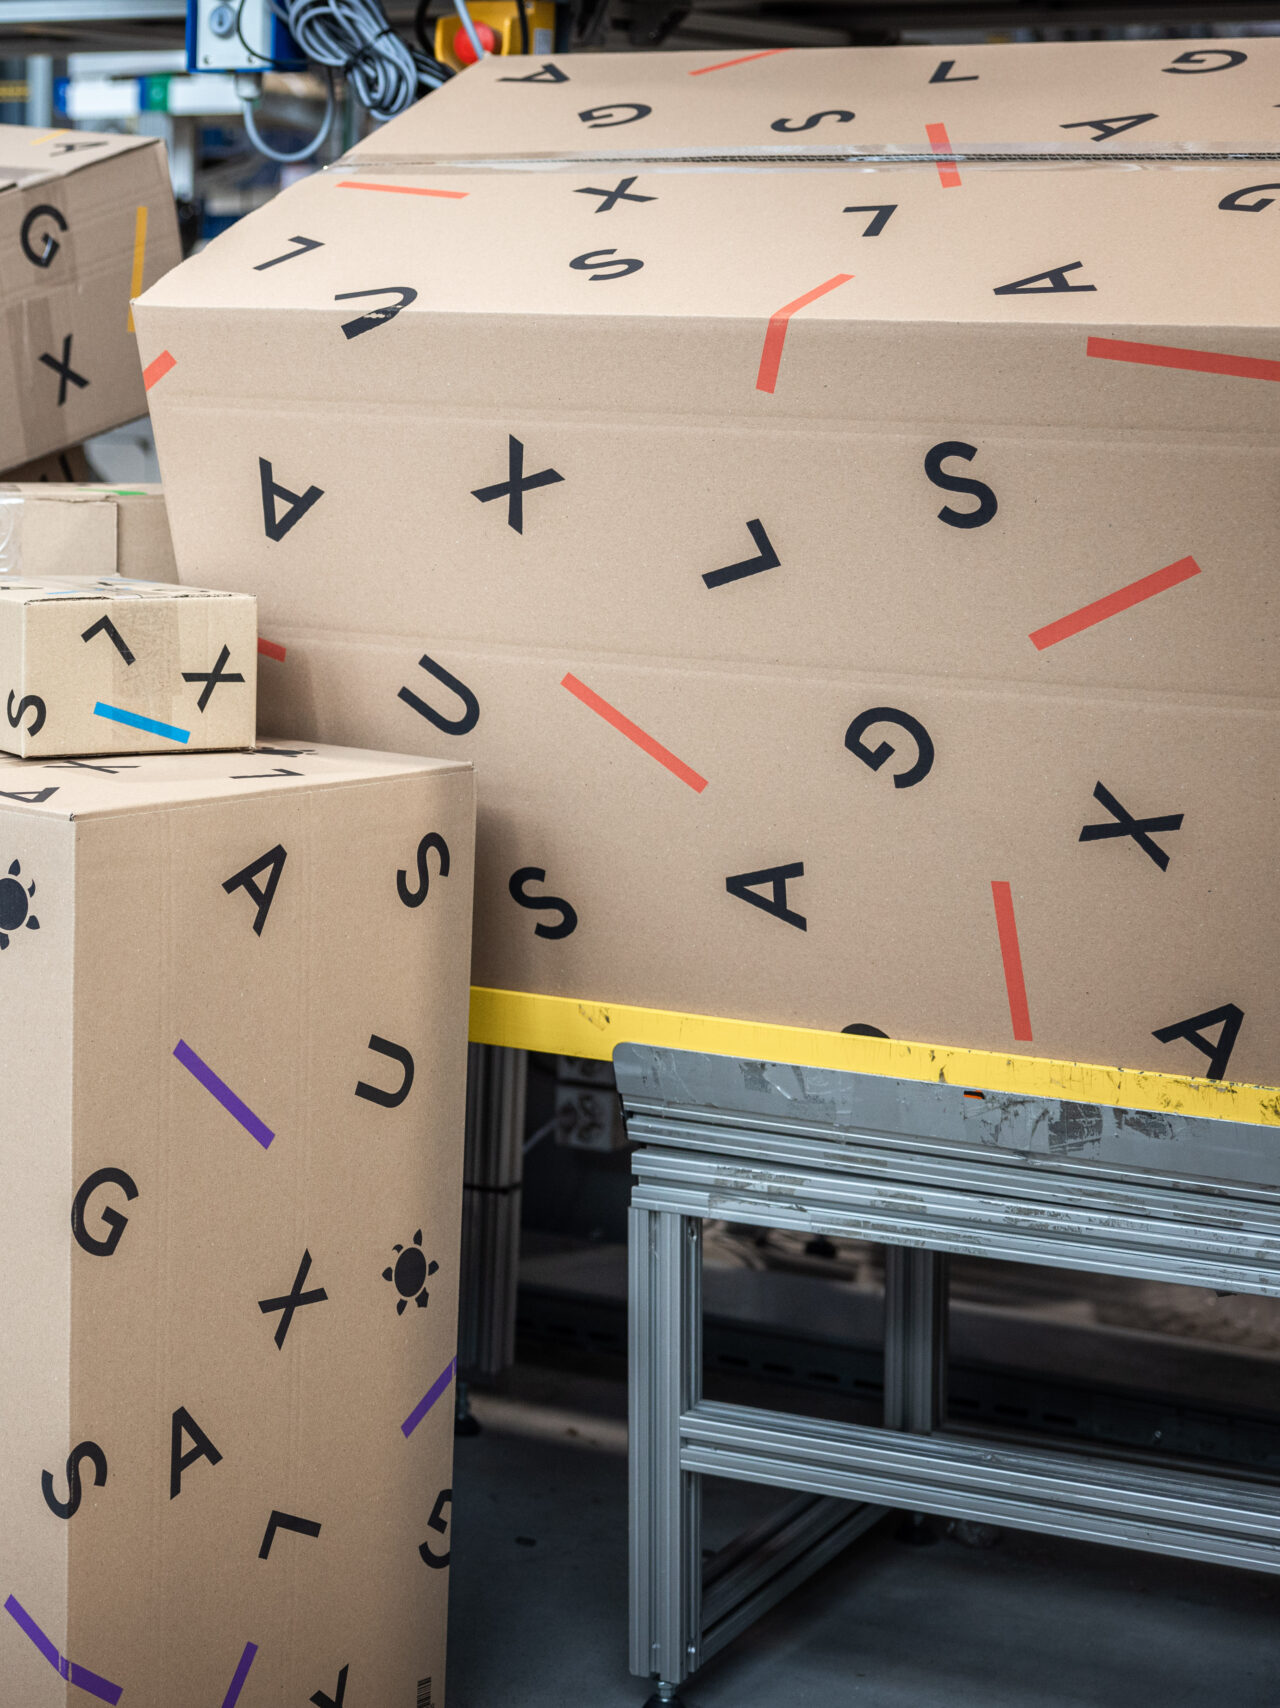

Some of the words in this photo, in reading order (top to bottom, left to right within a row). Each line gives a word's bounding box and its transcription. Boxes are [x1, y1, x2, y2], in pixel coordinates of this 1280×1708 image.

[495, 63, 571, 84] A
[1161, 49, 1248, 75] G
[578, 103, 652, 128] G
[770, 110, 856, 133] S
[1060, 113, 1159, 142] A
[575, 176, 657, 213] X
[1218, 182, 1280, 213] G
[19, 203, 70, 270] G
[254, 236, 325, 271] L
[569, 248, 644, 281] S
[333, 285, 419, 340] U
[993, 260, 1098, 296] A
[37, 333, 90, 407] X
[258, 457, 325, 543] A
[470, 434, 566, 535] X
[924, 440, 999, 530] S
[701, 518, 782, 590] L
[80, 614, 136, 666] L
[7, 689, 47, 737] S
[181, 644, 246, 713] X
[397, 654, 480, 736] U
[42, 760, 141, 774] X
[844, 706, 935, 789] G
[1078, 780, 1185, 873] X
[221, 843, 288, 938] A
[396, 831, 451, 909] S
[508, 866, 579, 941] S
[725, 861, 808, 933] A
[354, 1033, 415, 1109] U
[1150, 1002, 1246, 1083] A
[70, 1166, 140, 1257] G
[257, 1247, 329, 1352] X
[41, 1440, 108, 1520] S
[169, 1405, 224, 1501] A
[257, 1509, 322, 1561] L
